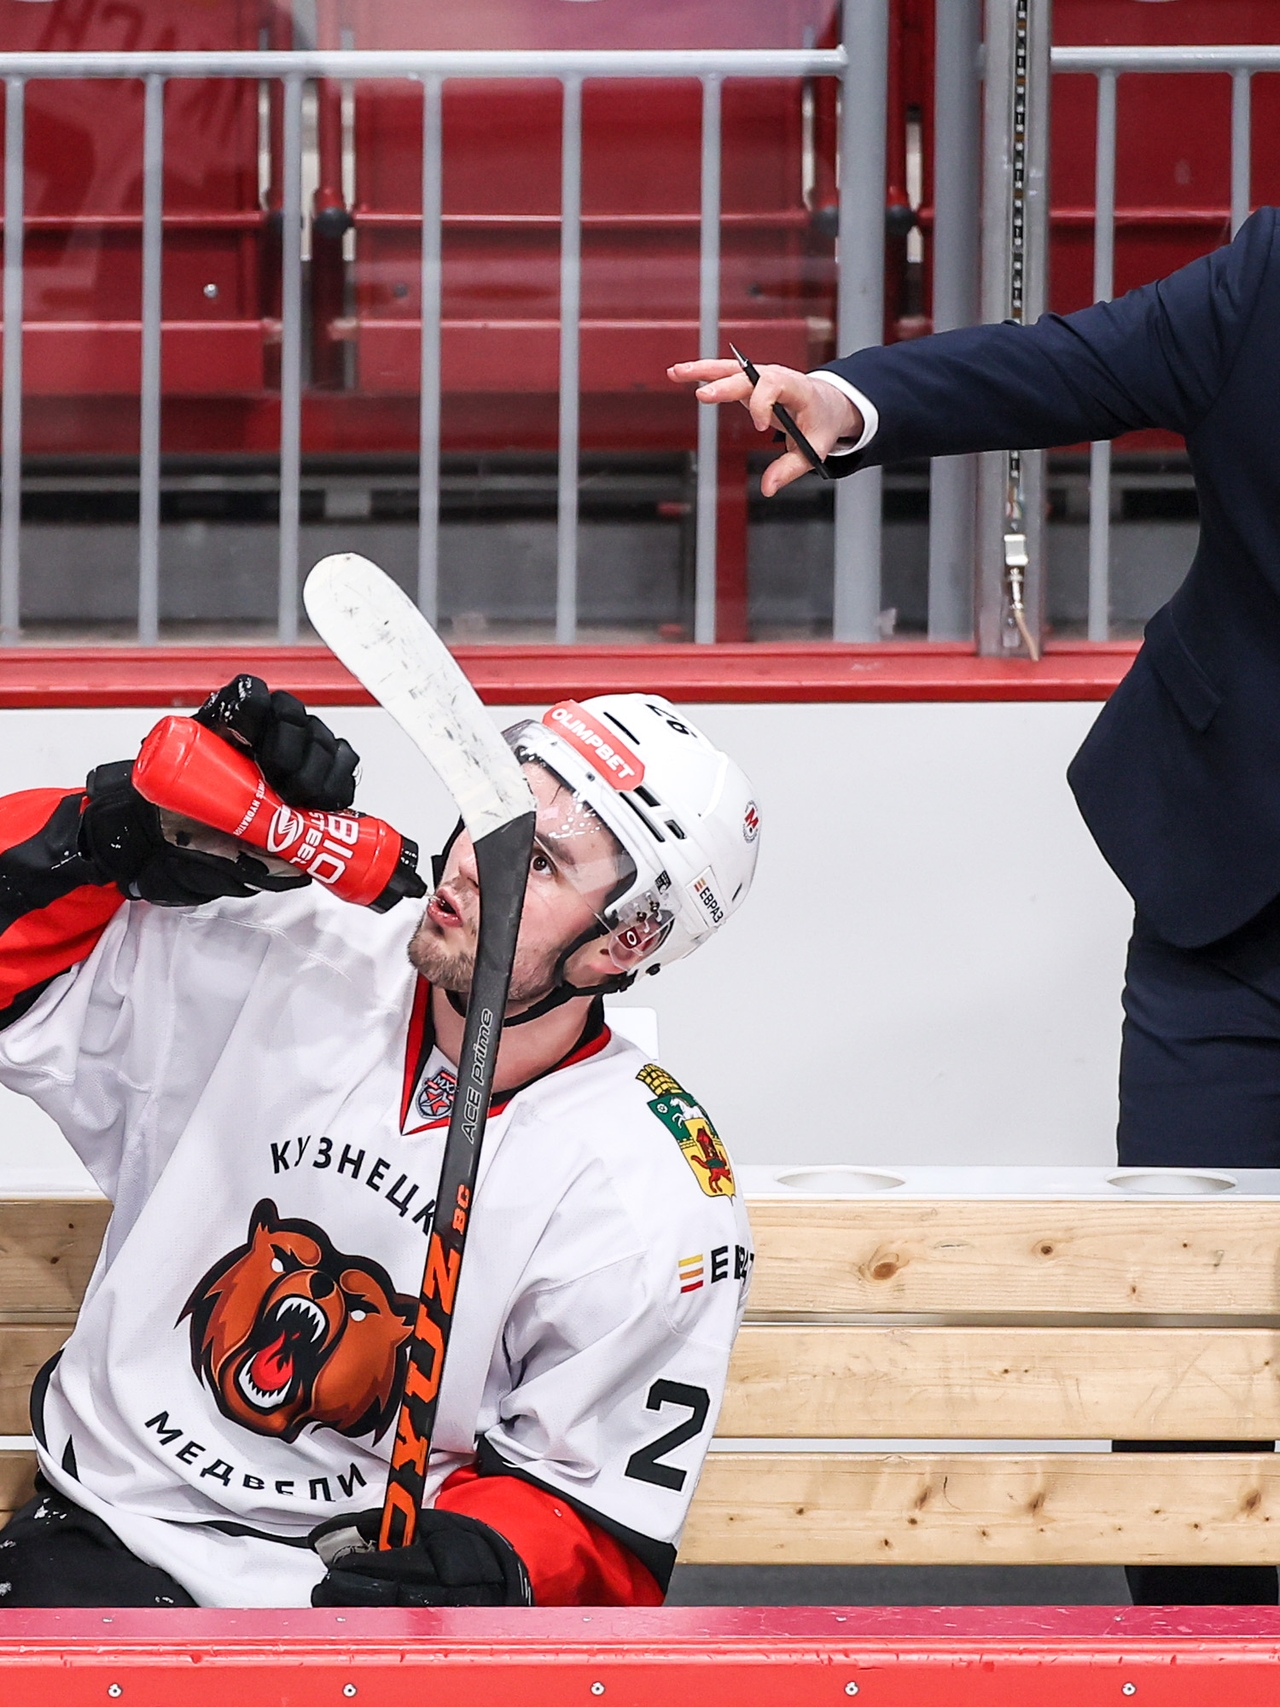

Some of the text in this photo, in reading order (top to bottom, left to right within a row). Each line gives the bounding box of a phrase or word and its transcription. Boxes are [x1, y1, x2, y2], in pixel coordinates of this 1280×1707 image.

[551, 707, 635, 779] OLIMPBET
[306, 814, 359, 884] BIO
[699, 886, 724, 923] ЕВРАЗ
[461, 1085, 482, 1145] ACE
[624, 1378, 711, 1492] 2
